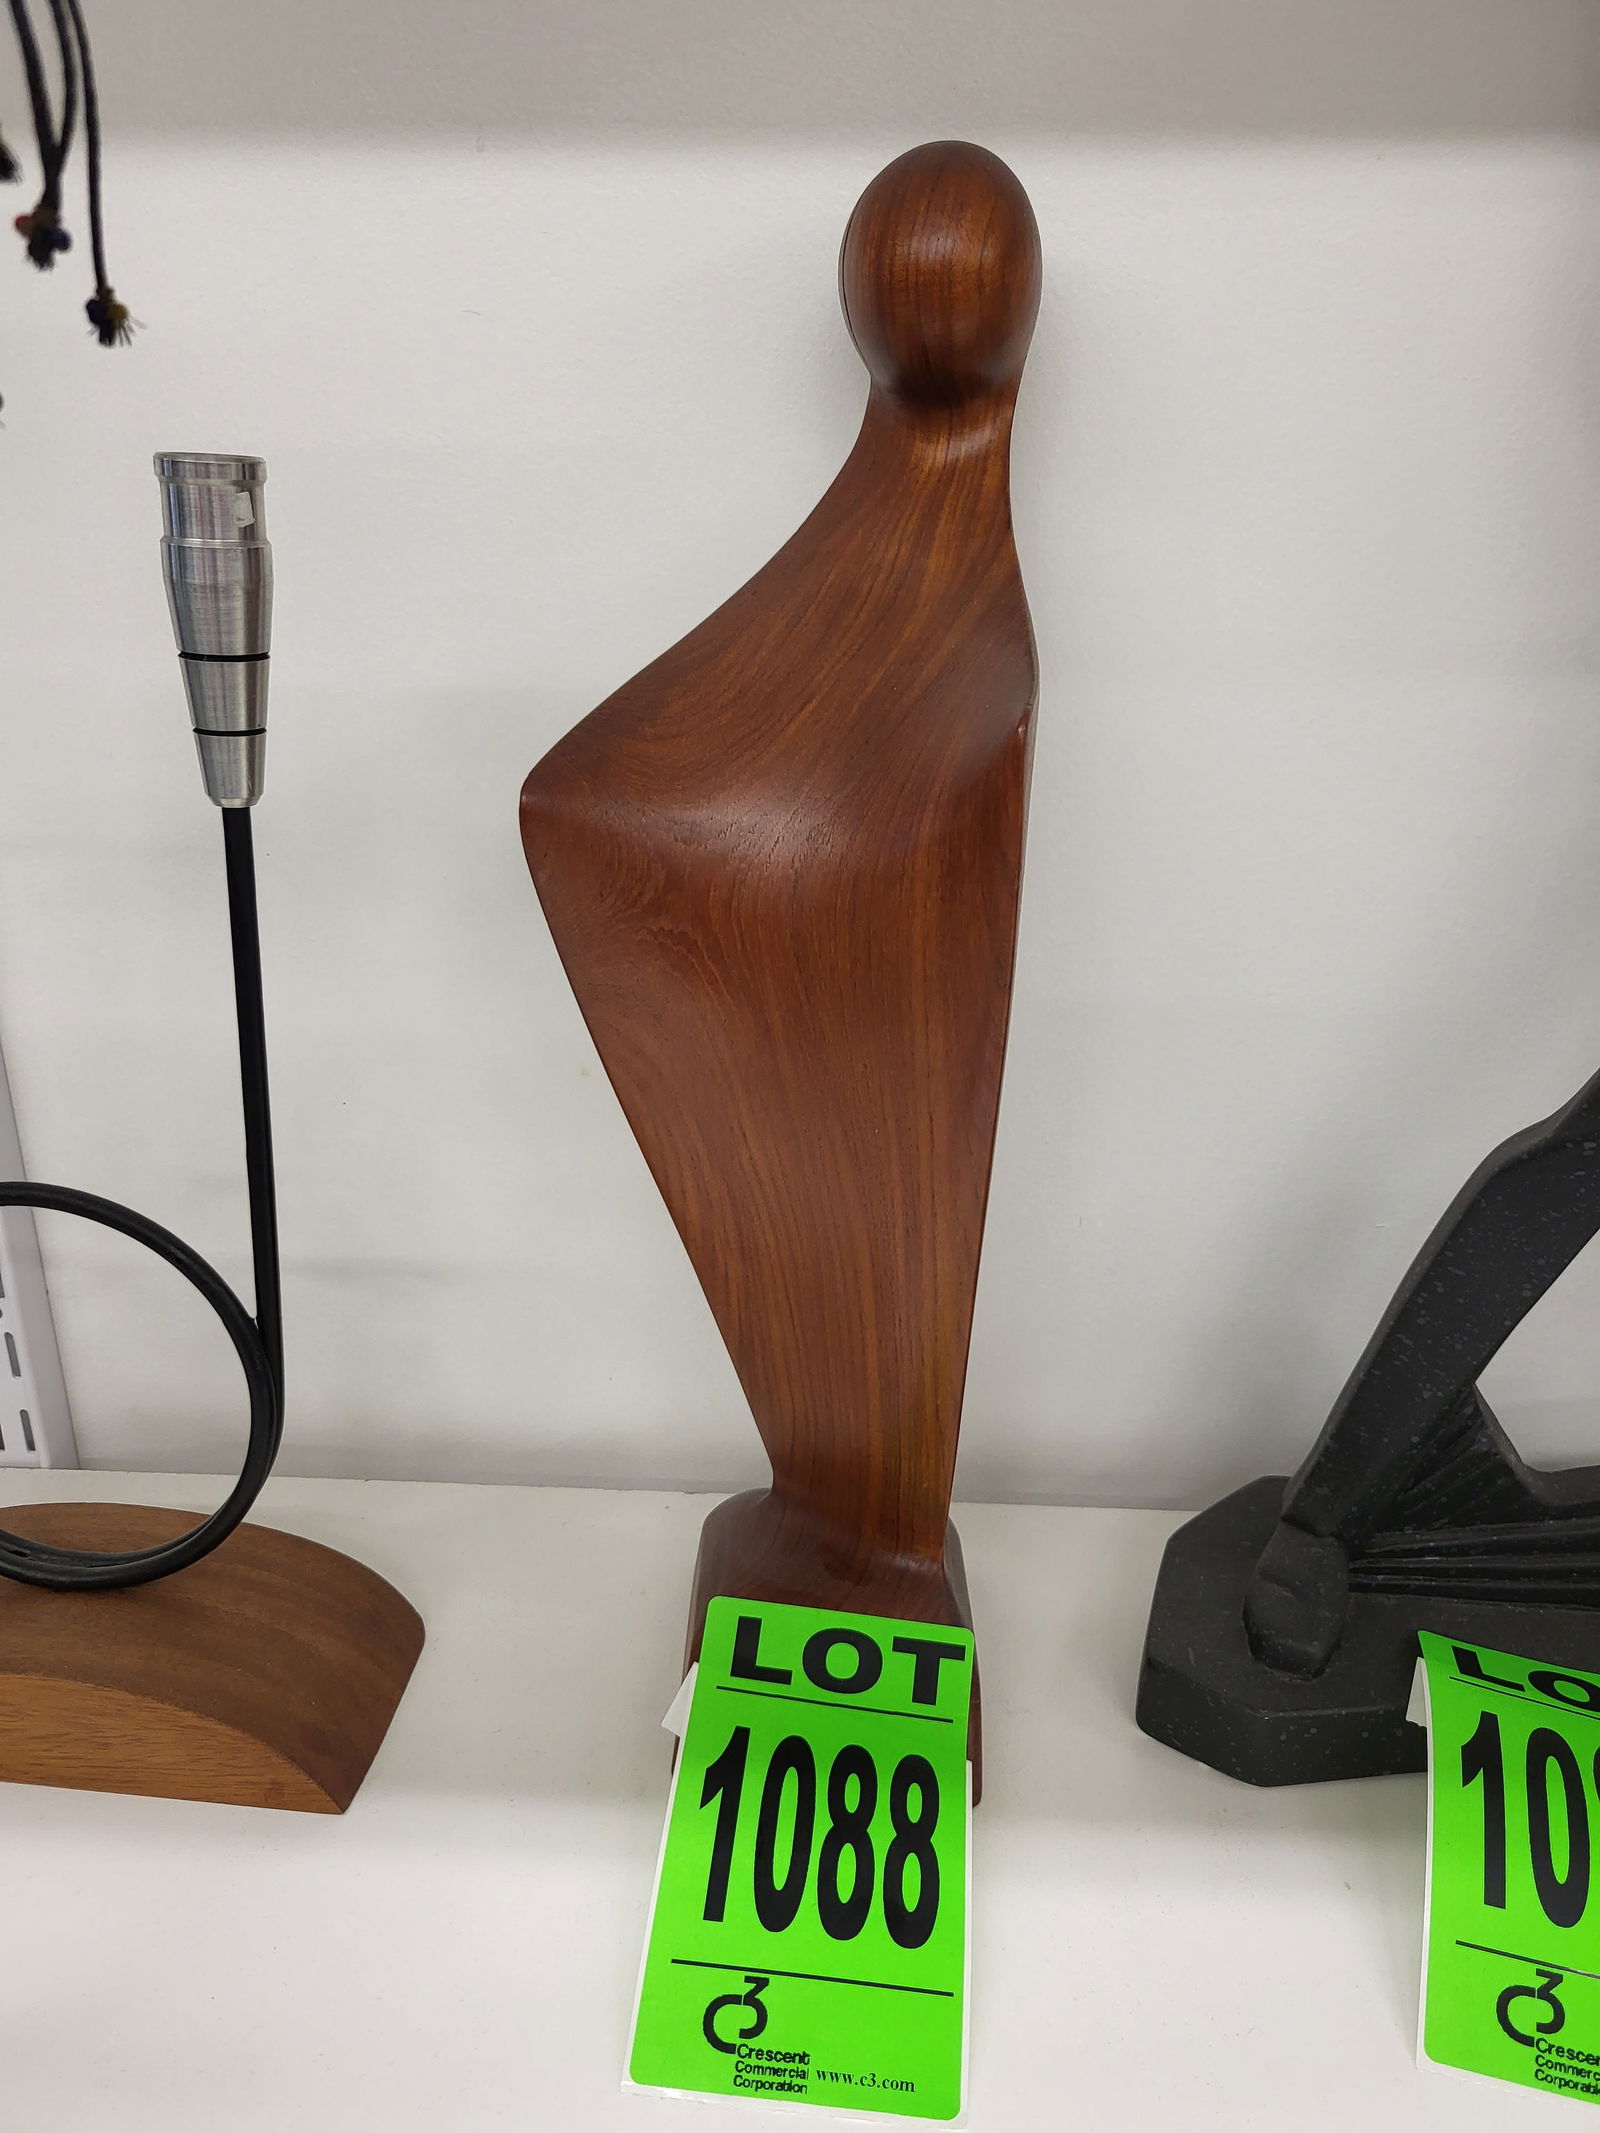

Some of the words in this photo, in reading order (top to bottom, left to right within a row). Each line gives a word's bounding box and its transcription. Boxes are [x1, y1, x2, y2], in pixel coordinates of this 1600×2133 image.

[730, 1615, 967, 1706] LOT
[1460, 1710, 1600, 1929] 10
[700, 1725, 940, 1950] 1088
[736, 2043, 810, 2066] Crescent
[735, 2060, 809, 2081] Commercial
[816, 2069, 916, 2093] www.c3.com
[1534, 2068, 1600, 2096] Corporati
[733, 2074, 808, 2095] Corporation
